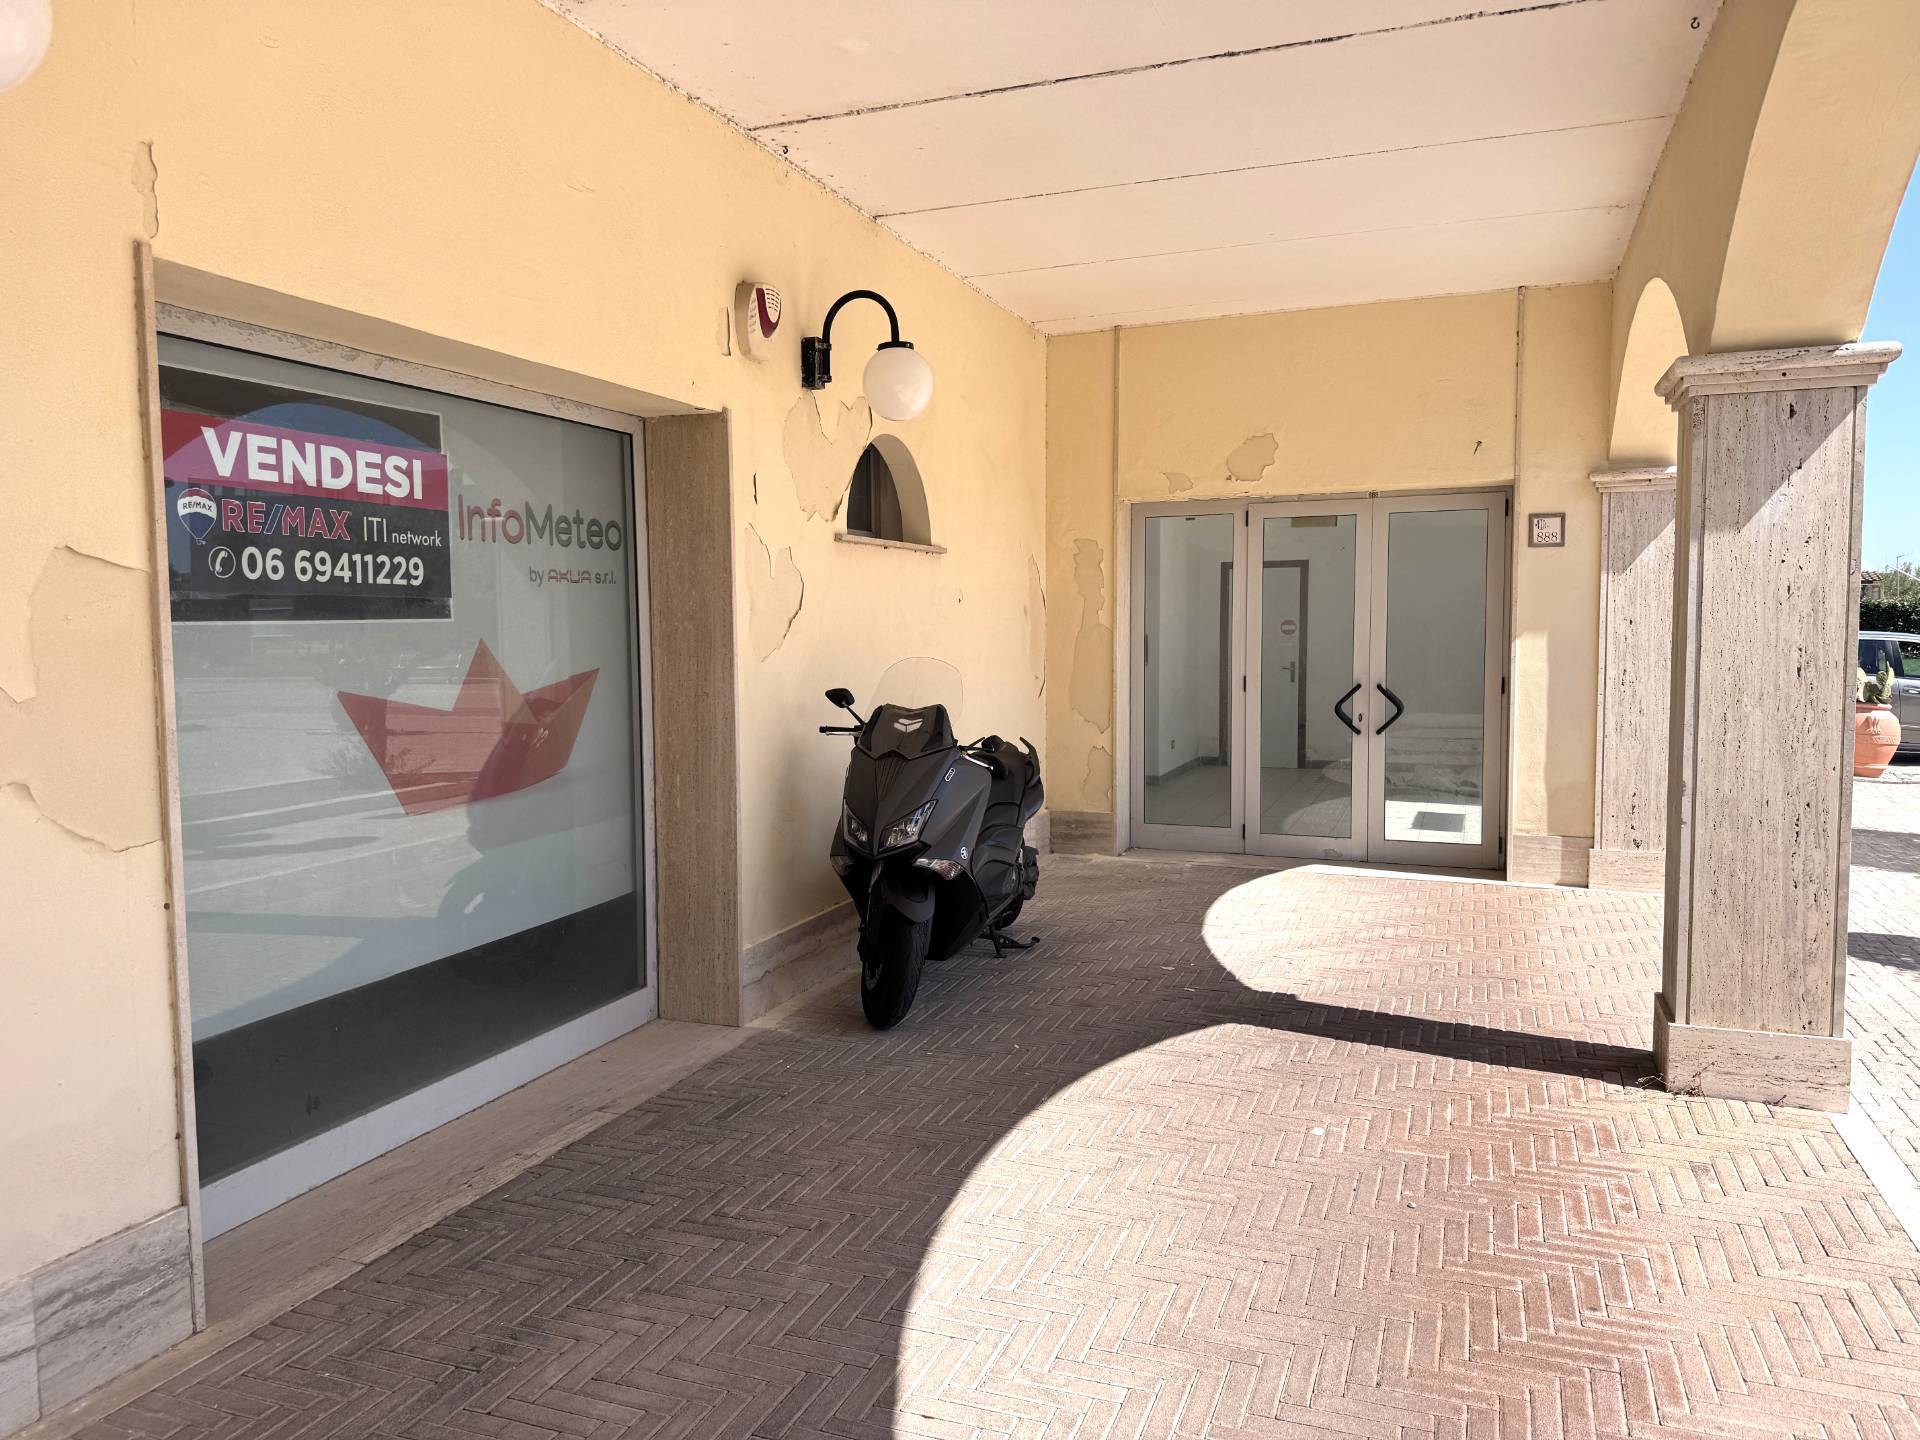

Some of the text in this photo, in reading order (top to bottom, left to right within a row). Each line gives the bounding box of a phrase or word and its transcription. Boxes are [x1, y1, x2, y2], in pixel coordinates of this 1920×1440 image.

[201, 426, 422, 499] VENDESI
[182, 500, 213, 513] RE/MAX
[221, 498, 350, 540] RE/MAX
[392, 530, 442, 547] network
[458, 493, 622, 551] InfoMeteo
[1536, 531, 1558, 543] 888
[241, 546, 424, 586] 06 69411229
[529, 566, 544, 587] by
[594, 570, 617, 585] s.r.l.
